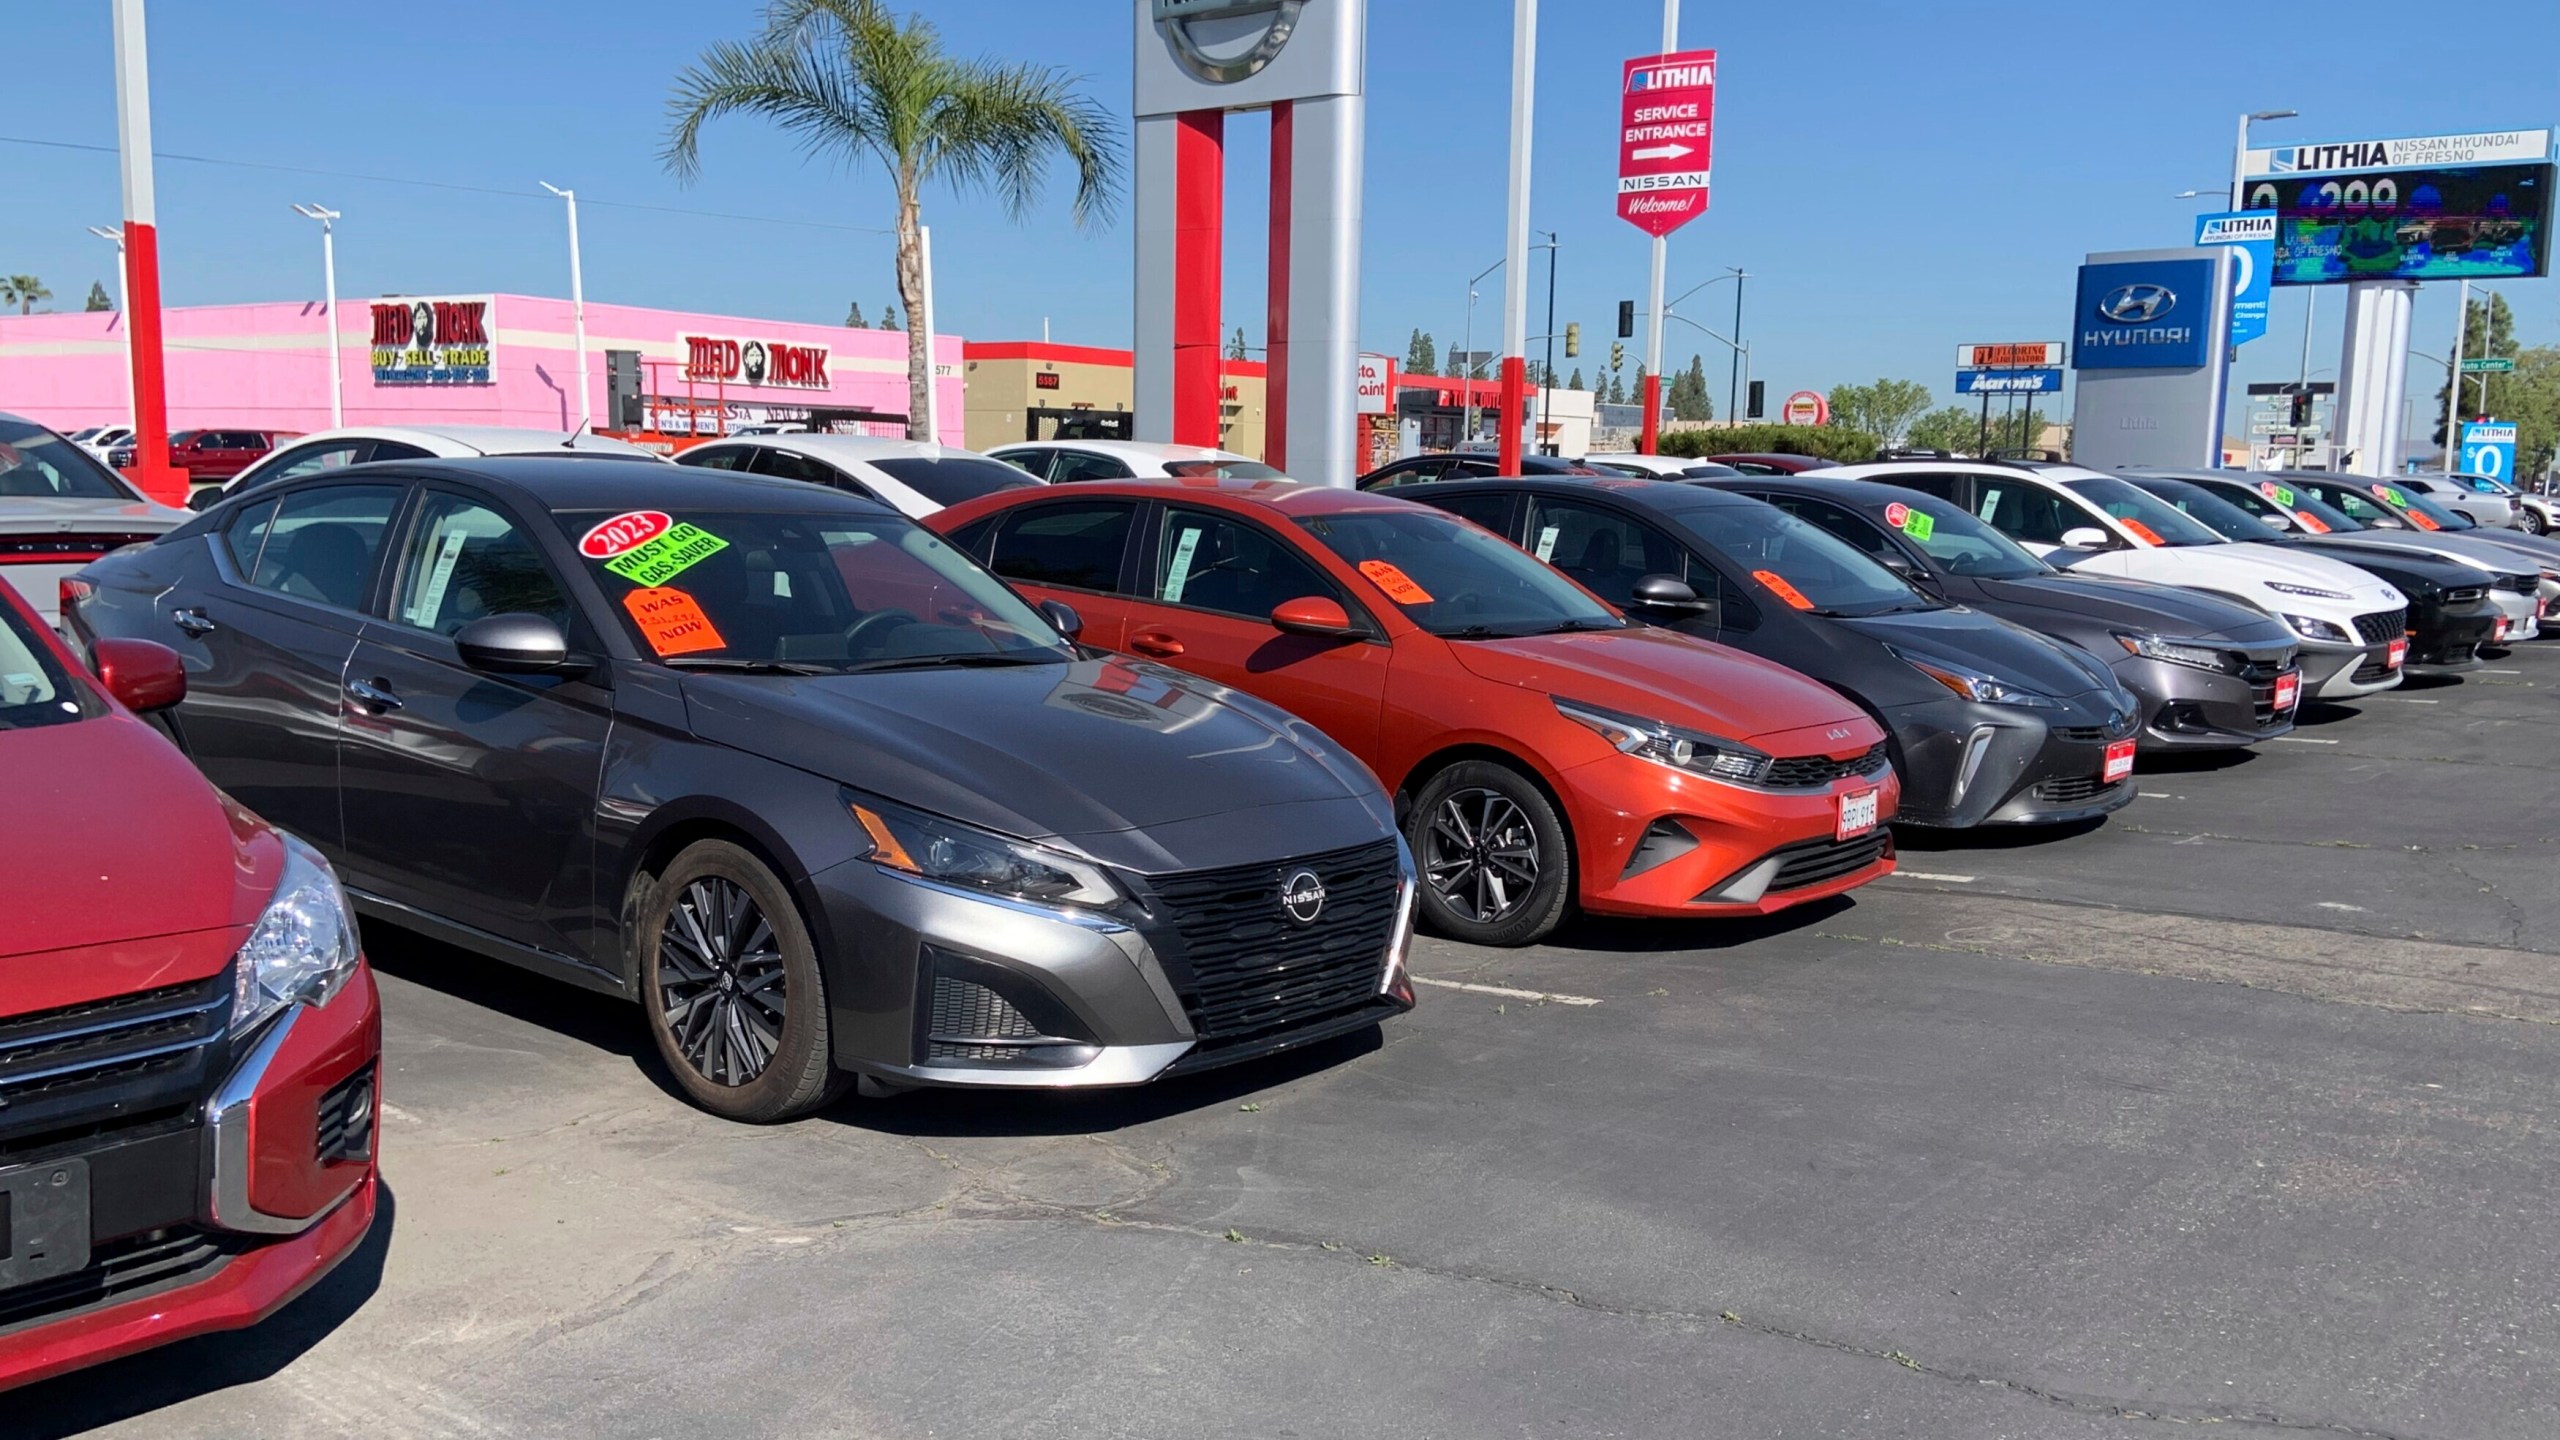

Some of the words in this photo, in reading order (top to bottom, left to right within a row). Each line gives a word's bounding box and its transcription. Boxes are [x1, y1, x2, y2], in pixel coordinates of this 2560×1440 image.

[1647, 65, 1713, 90] LITHIA
[1634, 104, 1698, 122] SERVICE
[1625, 123, 1706, 142] ENTRANCE
[2393, 138, 2448, 152] NISSAN
[2453, 133, 2520, 148] HYUNDAI
[2297, 143, 2389, 171] LITHIA
[2392, 153, 2411, 165] OF
[2415, 149, 2475, 164] FRESNO
[1624, 174, 1703, 191] NISSAN
[1628, 193, 1696, 215] Welcome!
[2221, 218, 2273, 233] LITHIA
[2204, 233, 2233, 241] HYUNDAI
[370, 304, 414, 346] MAD
[432, 302, 488, 345] MONK
[2083, 327, 2191, 346] HYUNDAI
[371, 350, 395, 366] BUY
[404, 350, 433, 366] SELL
[442, 349, 488, 366] TRADE
[685, 337, 740, 380] MAD
[767, 343, 829, 388] MONK
[2460, 362, 2479, 370] Auto
[2480, 361, 2506, 370] Center
[1358, 380, 1385, 396] aint
[1969, 374, 2044, 390] Aaron's
[1480, 392, 1501, 409] OUTL
[651, 419, 673, 428] MN'S
[682, 420, 716, 430] WMEN'S
[2481, 428, 2514, 437] LITHIA
[593, 514, 656, 554] 2023
[613, 538, 669, 574] MUST
[668, 525, 698, 543] GO
[640, 595, 684, 613] WAS
[659, 621, 702, 641] NOW
[1282, 888, 1326, 906] NISSAN
